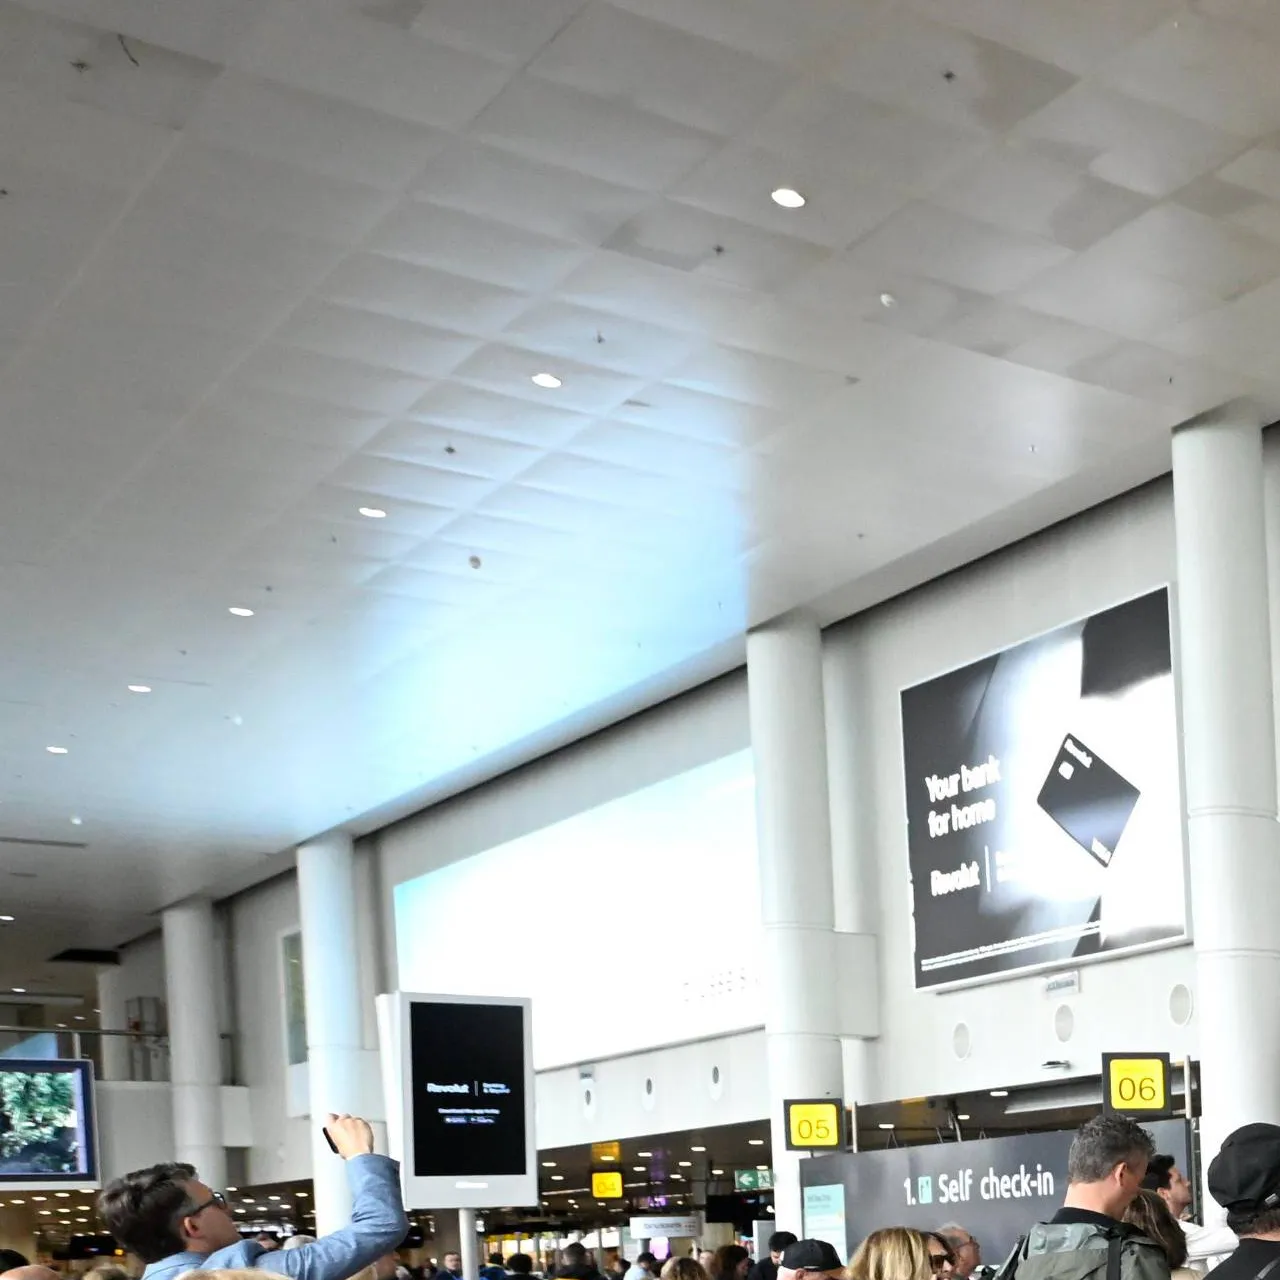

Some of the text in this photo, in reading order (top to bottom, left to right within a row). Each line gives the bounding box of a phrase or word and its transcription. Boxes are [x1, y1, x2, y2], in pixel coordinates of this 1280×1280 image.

[925, 755, 1001, 802] Your bank
[928, 798, 996, 838] for home
[1118, 1077, 1156, 1101] 06
[798, 1119, 830, 1139] 05
[597, 1182, 616, 1194] 04
[904, 1164, 1054, 1205] 1. Self check-in
